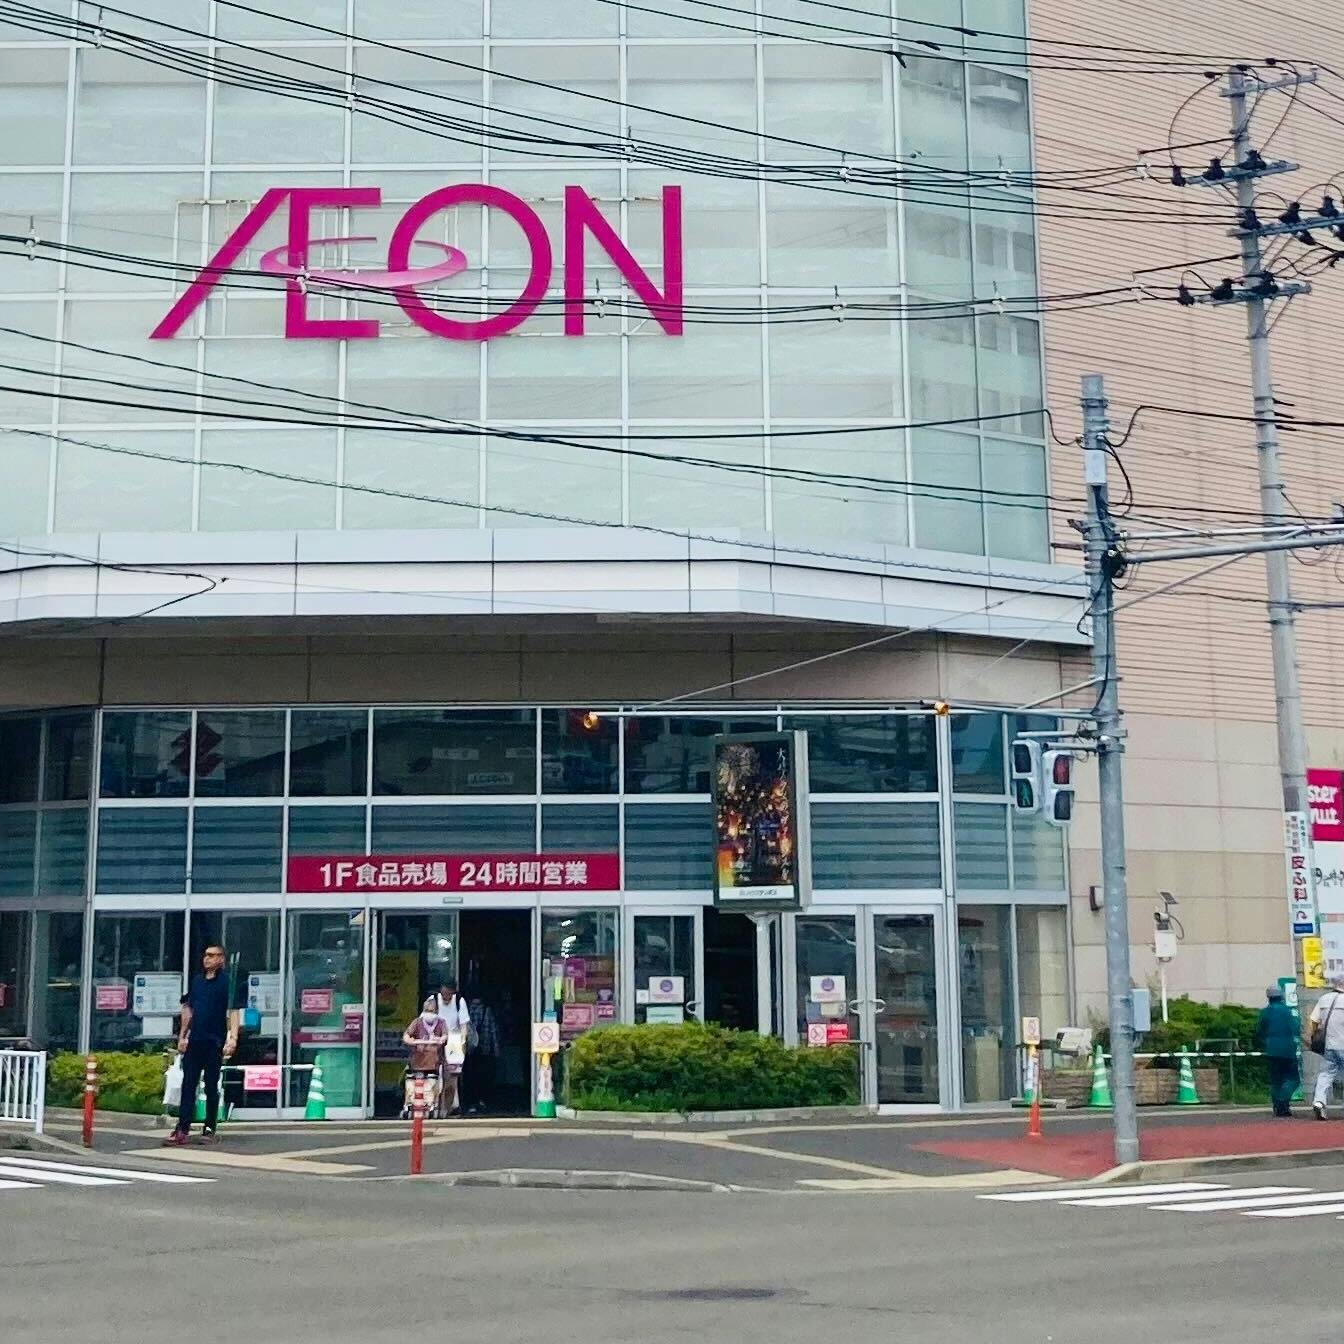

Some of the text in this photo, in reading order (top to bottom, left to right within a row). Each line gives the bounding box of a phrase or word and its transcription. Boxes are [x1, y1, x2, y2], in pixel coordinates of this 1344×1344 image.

[1307, 785, 1338, 803] ster
[320, 862, 587, 887] 1F食品売場 24時間営業
